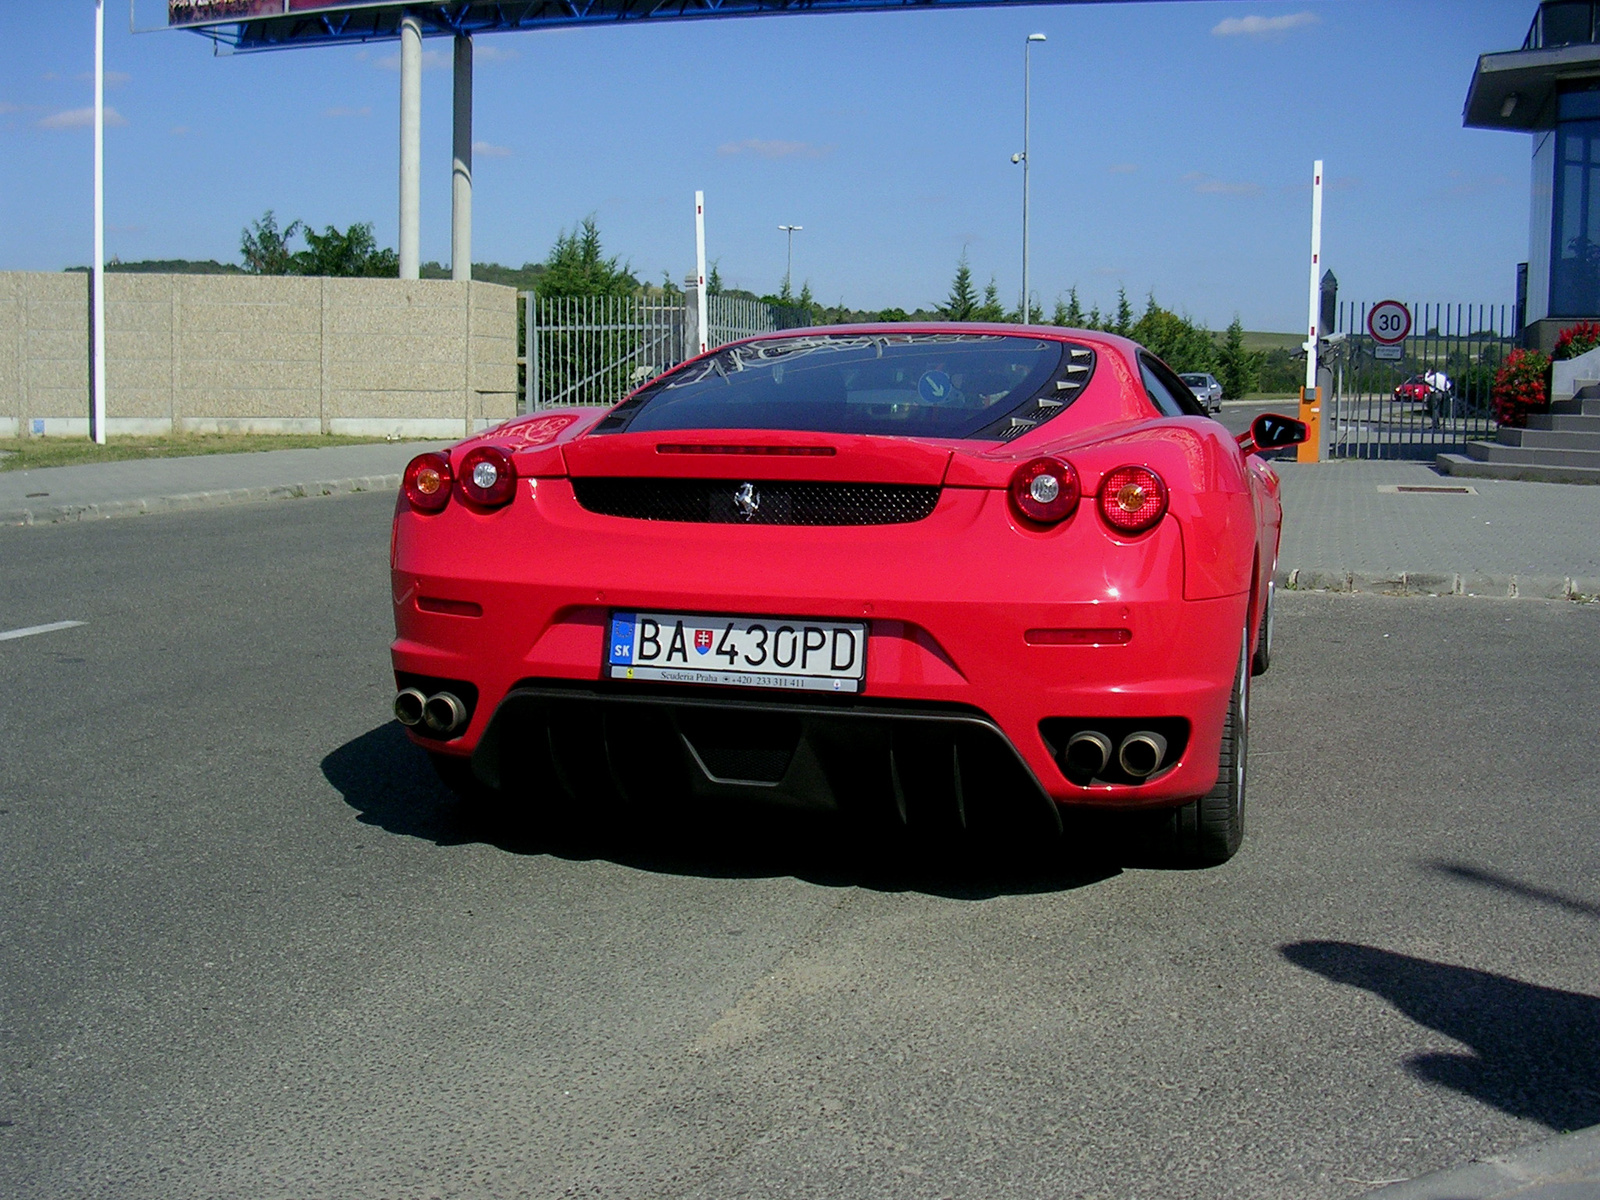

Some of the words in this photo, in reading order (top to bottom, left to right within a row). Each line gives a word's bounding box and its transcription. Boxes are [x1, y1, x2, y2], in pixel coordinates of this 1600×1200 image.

[1379, 314, 1400, 331] 30
[614, 645, 630, 657] SK
[638, 618, 688, 662] BA
[715, 622, 856, 671] 430PD
[660, 671, 694, 682] Scuderia
[696, 672, 718, 683] Praha
[756, 677, 773, 686] 233
[789, 678, 805, 688] 411
